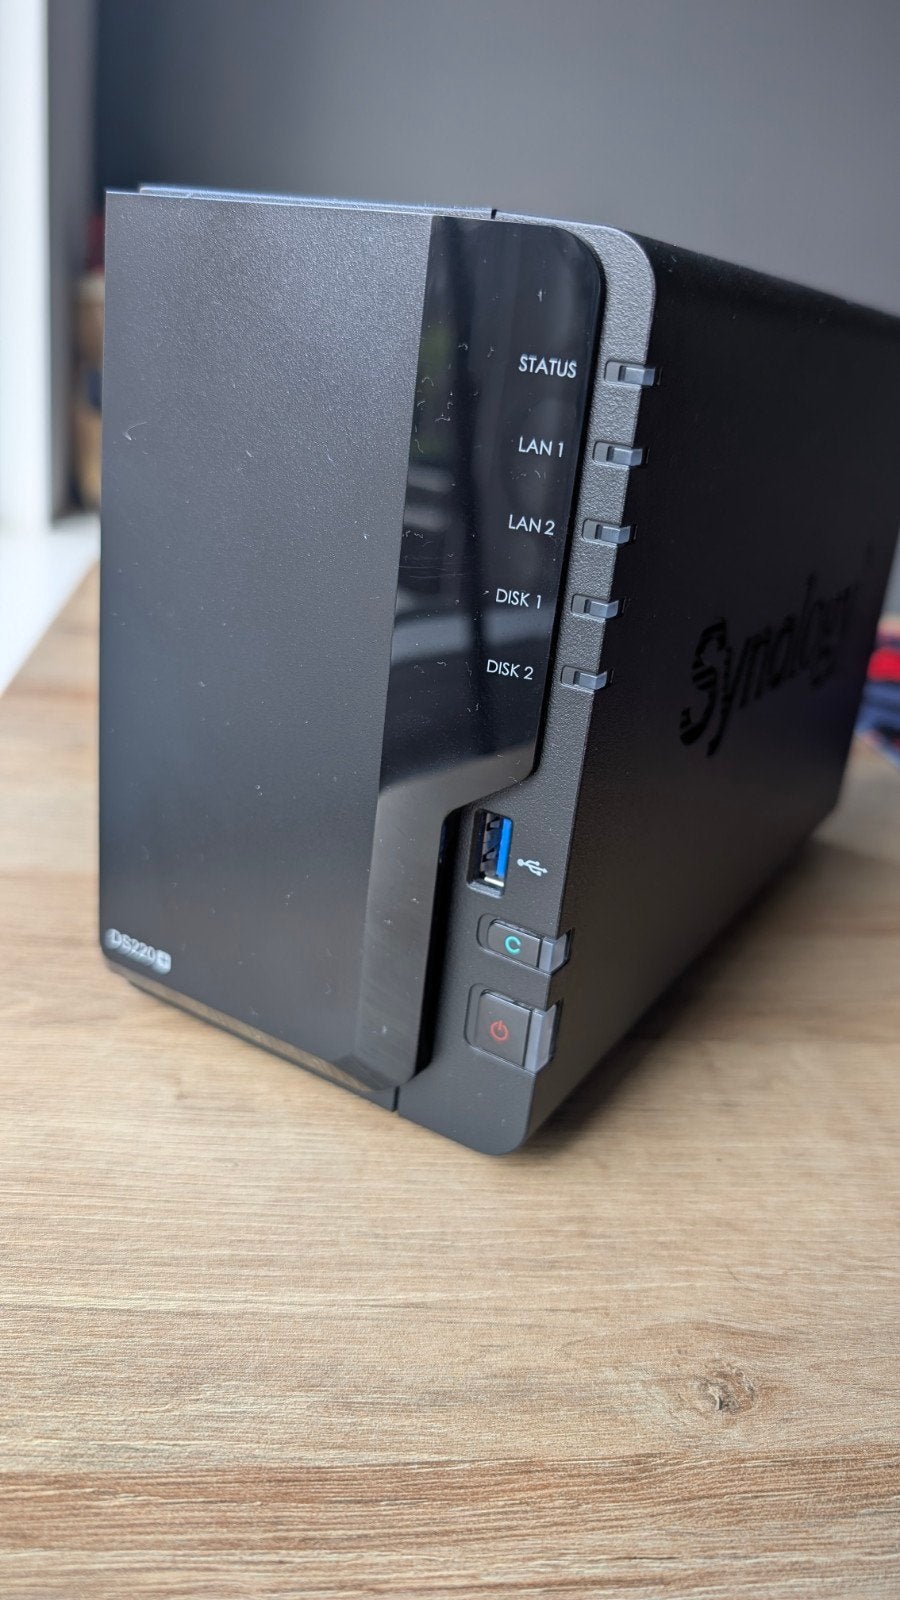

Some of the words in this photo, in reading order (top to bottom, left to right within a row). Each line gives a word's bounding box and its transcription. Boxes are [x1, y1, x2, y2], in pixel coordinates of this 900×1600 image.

[518, 354, 577, 378] STATUS
[518, 436, 553, 457] LAN
[557, 441, 564, 458] 1
[508, 514, 541, 534] LAN
[544, 520, 555, 536] 2
[495, 588, 530, 607] DISK
[535, 594, 542, 609] 1
[486, 659, 520, 677] DISK
[523, 665, 534, 680] 2
[505, 935, 521, 953] C
